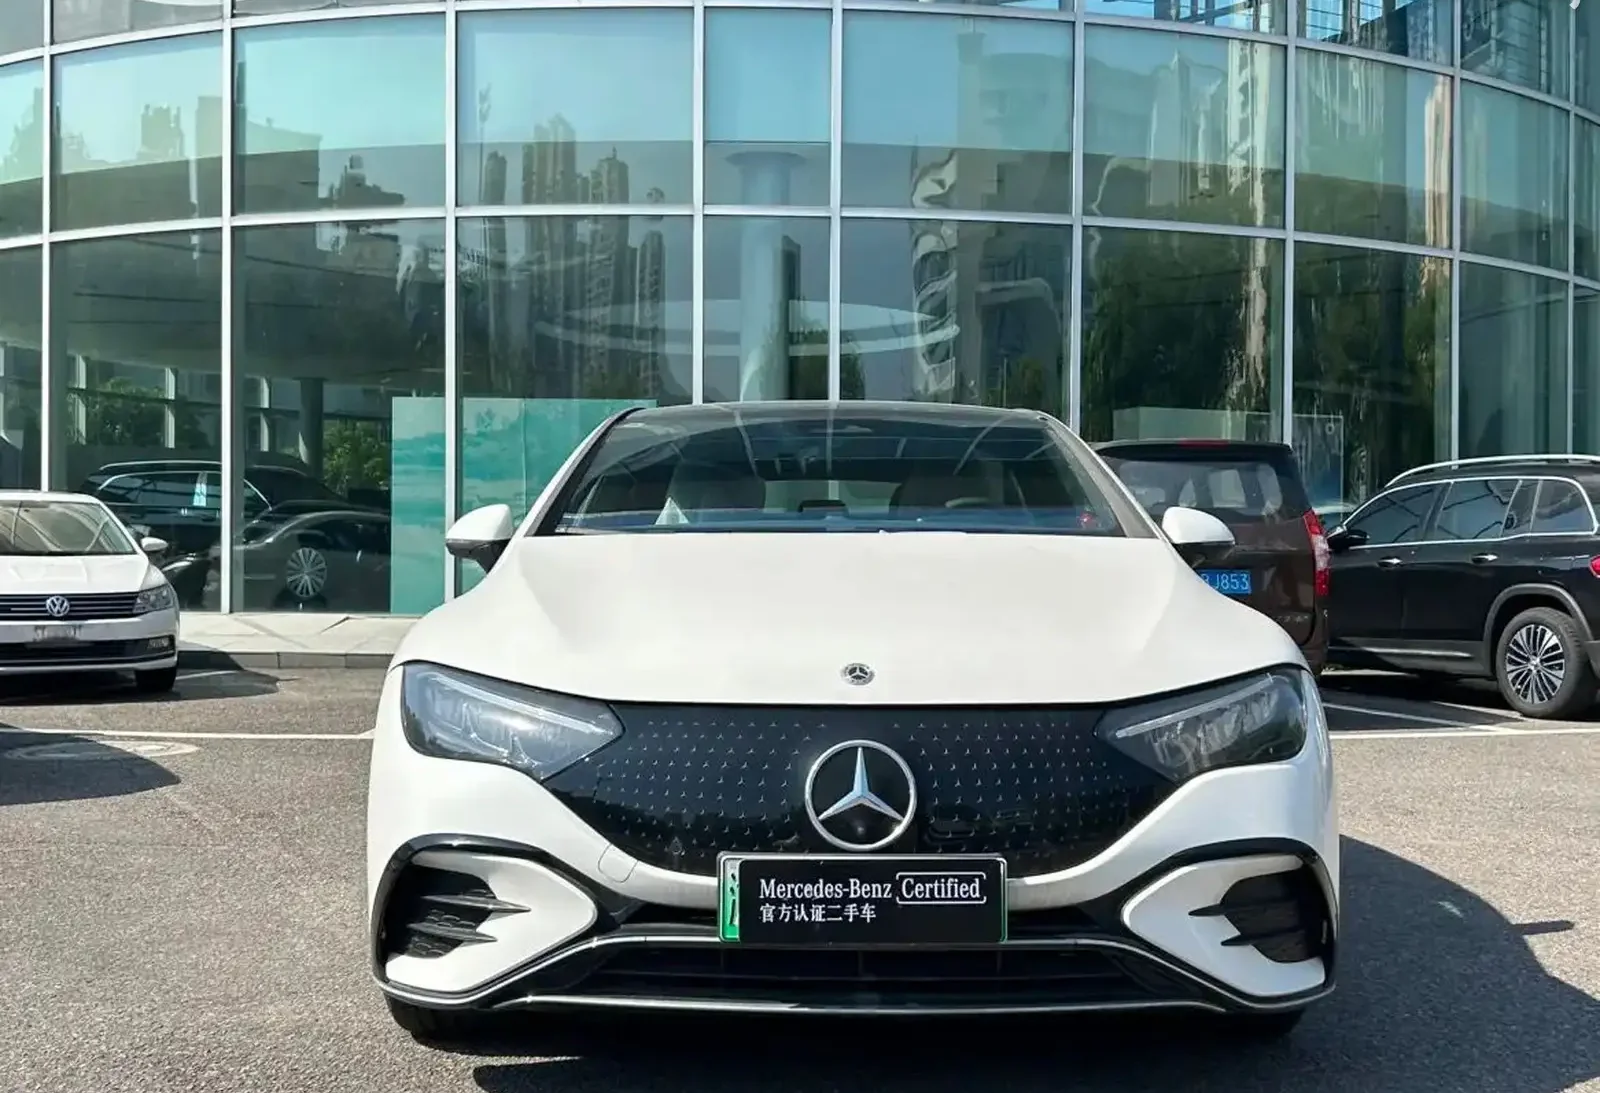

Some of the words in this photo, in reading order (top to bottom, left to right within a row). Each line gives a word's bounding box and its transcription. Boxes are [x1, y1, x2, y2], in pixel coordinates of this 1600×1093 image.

[759, 878, 892, 899] Mercedes-Benz
[901, 877, 980, 898] Certified
[759, 903, 876, 922] 官方认证二手车
